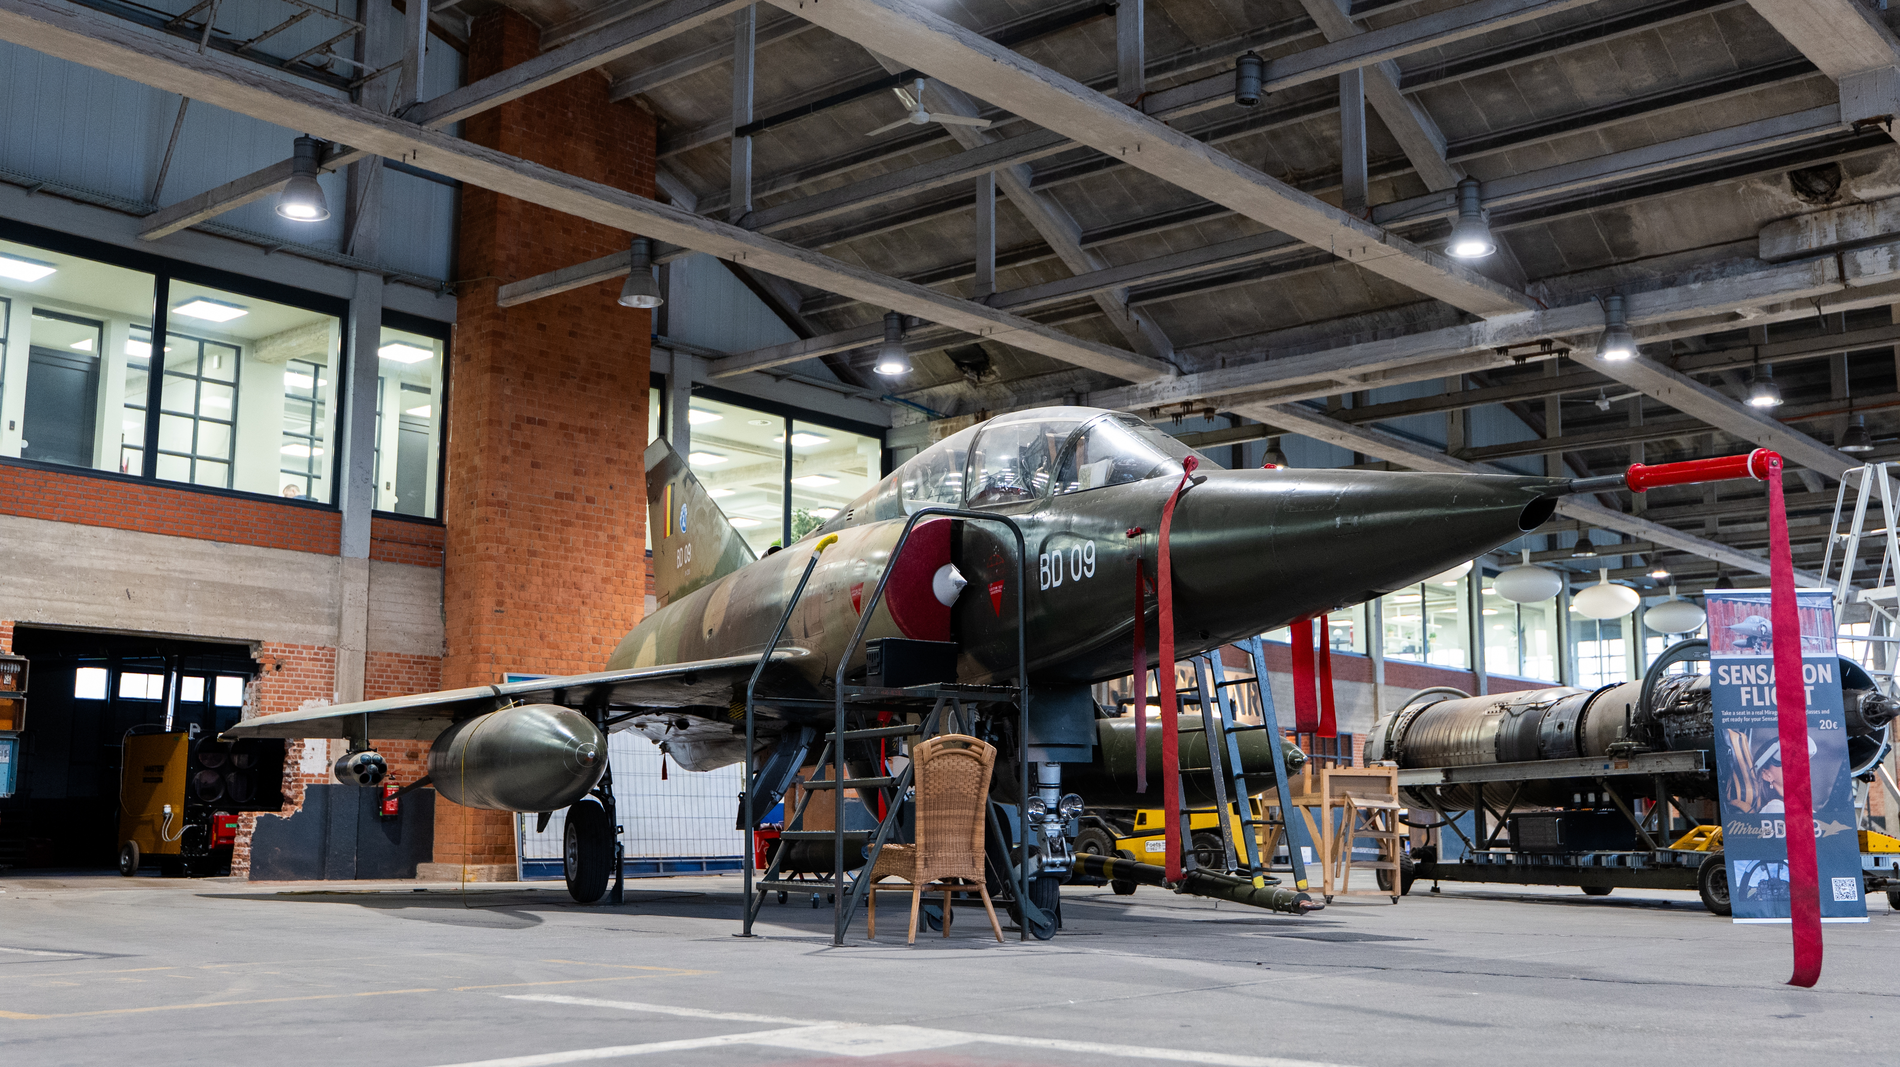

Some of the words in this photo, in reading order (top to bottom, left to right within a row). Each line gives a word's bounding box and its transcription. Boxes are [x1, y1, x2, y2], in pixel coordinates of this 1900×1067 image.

[677, 547, 683, 569] BD
[684, 542, 691, 564] 09
[1040, 549, 1063, 591] BD
[1070, 540, 1096, 582] 09
[1718, 663, 1832, 685] SENSON
[1740, 686, 1814, 706] FLIT
[1764, 709, 1778, 717] Mirag
[1819, 719, 1839, 730] 20€
[1760, 819, 1786, 839] BD
